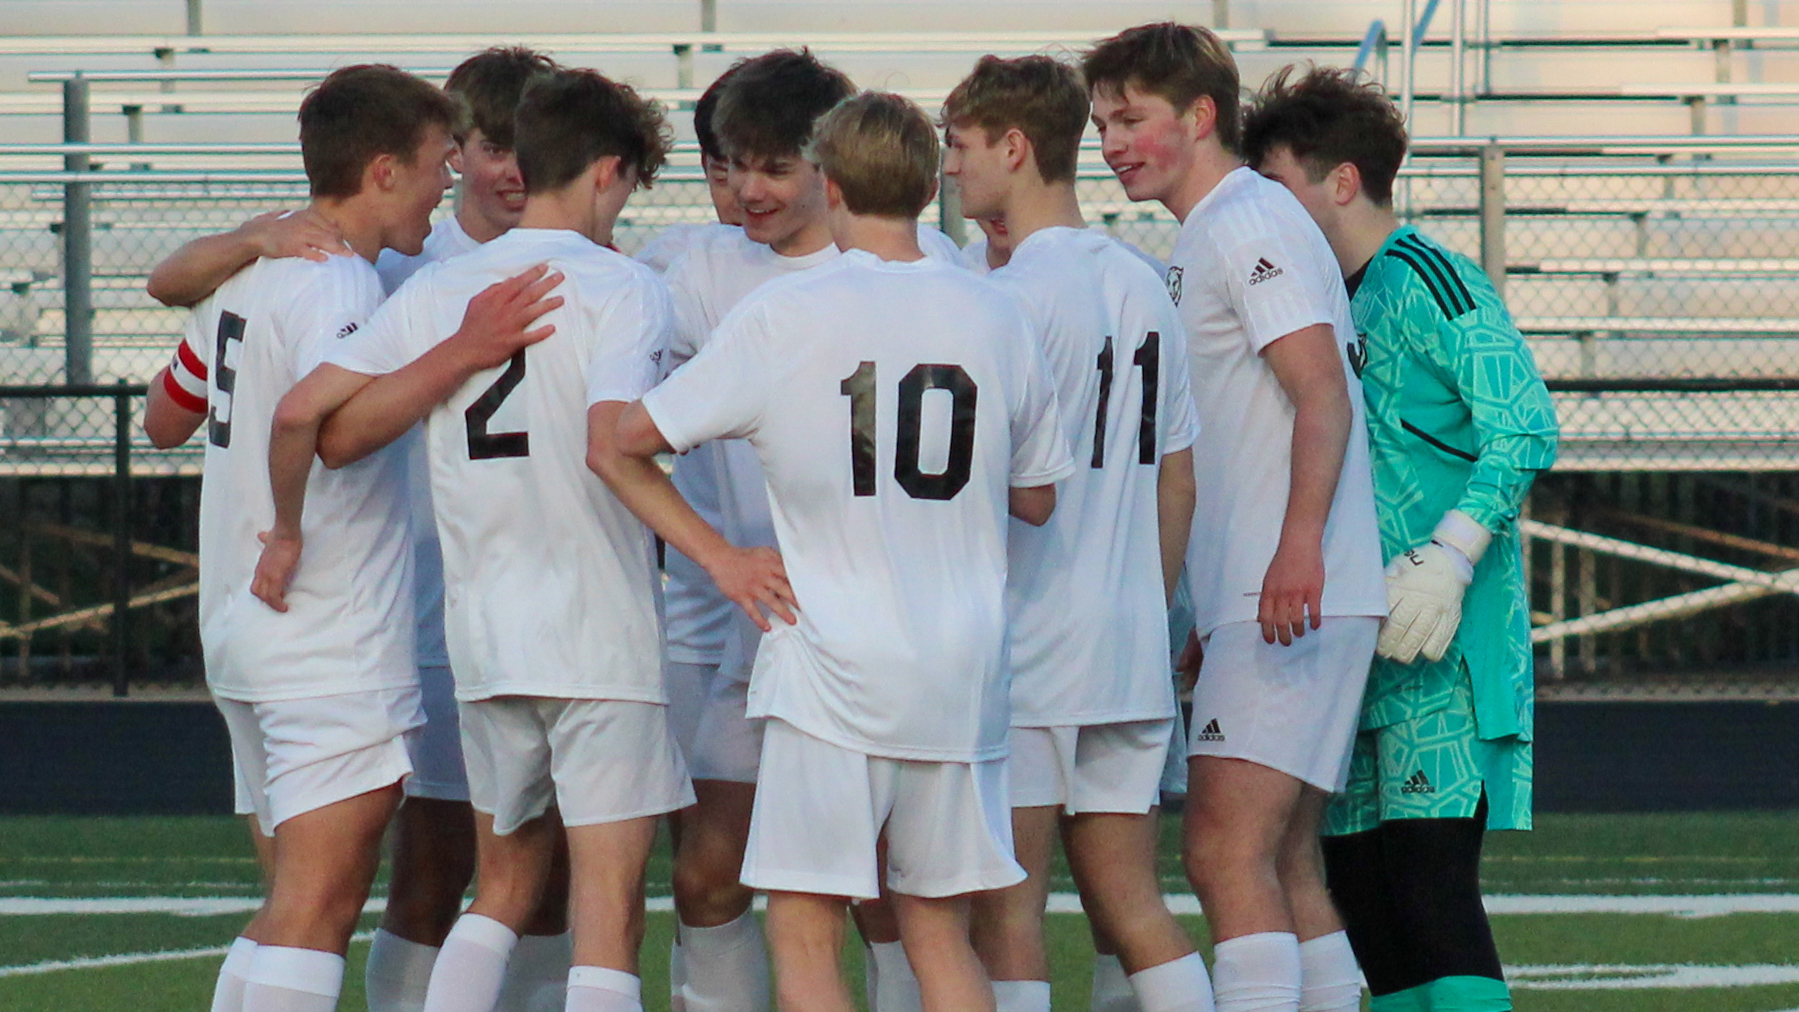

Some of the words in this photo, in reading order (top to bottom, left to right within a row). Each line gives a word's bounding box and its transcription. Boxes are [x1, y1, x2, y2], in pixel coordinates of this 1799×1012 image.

[208, 309, 248, 449] 5
[465, 347, 530, 460] 2
[840, 361, 978, 500] 10
[1091, 331, 1159, 469] 11
